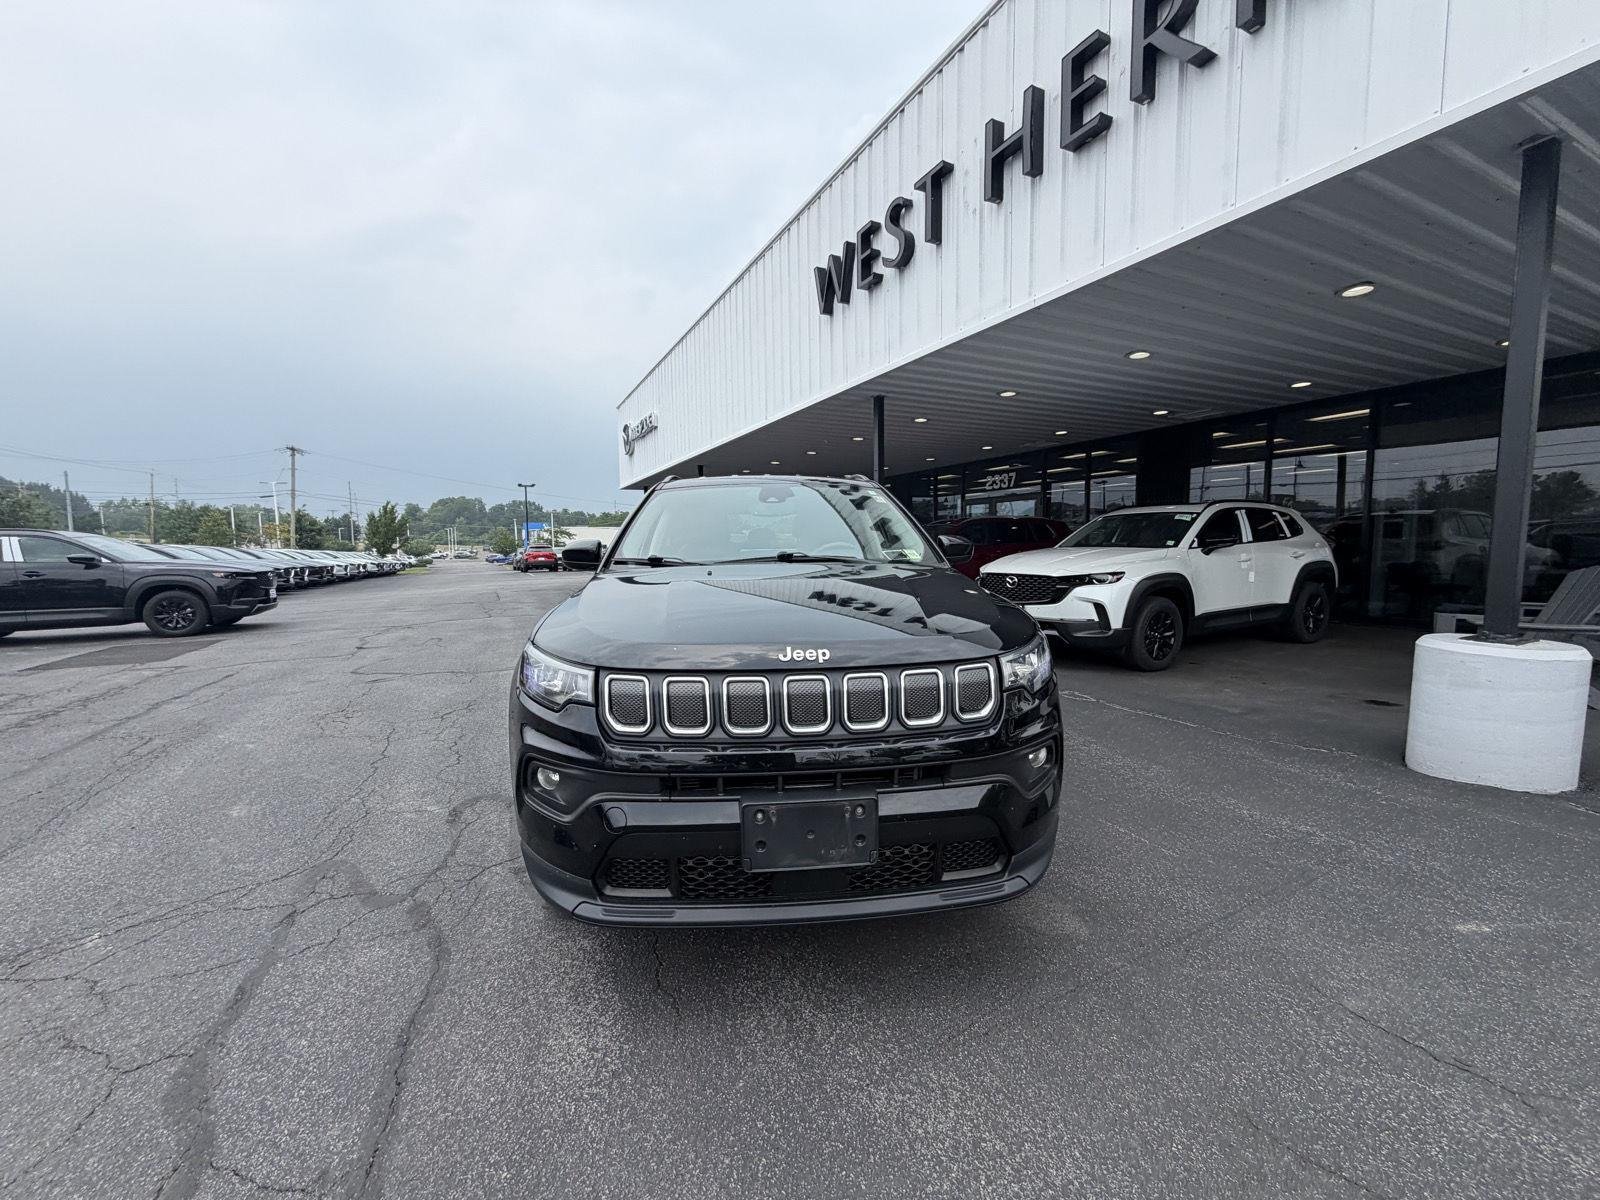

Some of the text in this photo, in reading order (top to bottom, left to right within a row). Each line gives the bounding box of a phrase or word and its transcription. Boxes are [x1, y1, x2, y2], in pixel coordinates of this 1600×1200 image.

[814, 0, 1268, 315] WEST HER
[985, 471, 1017, 491] 2337
[778, 646, 830, 663] Jeep
